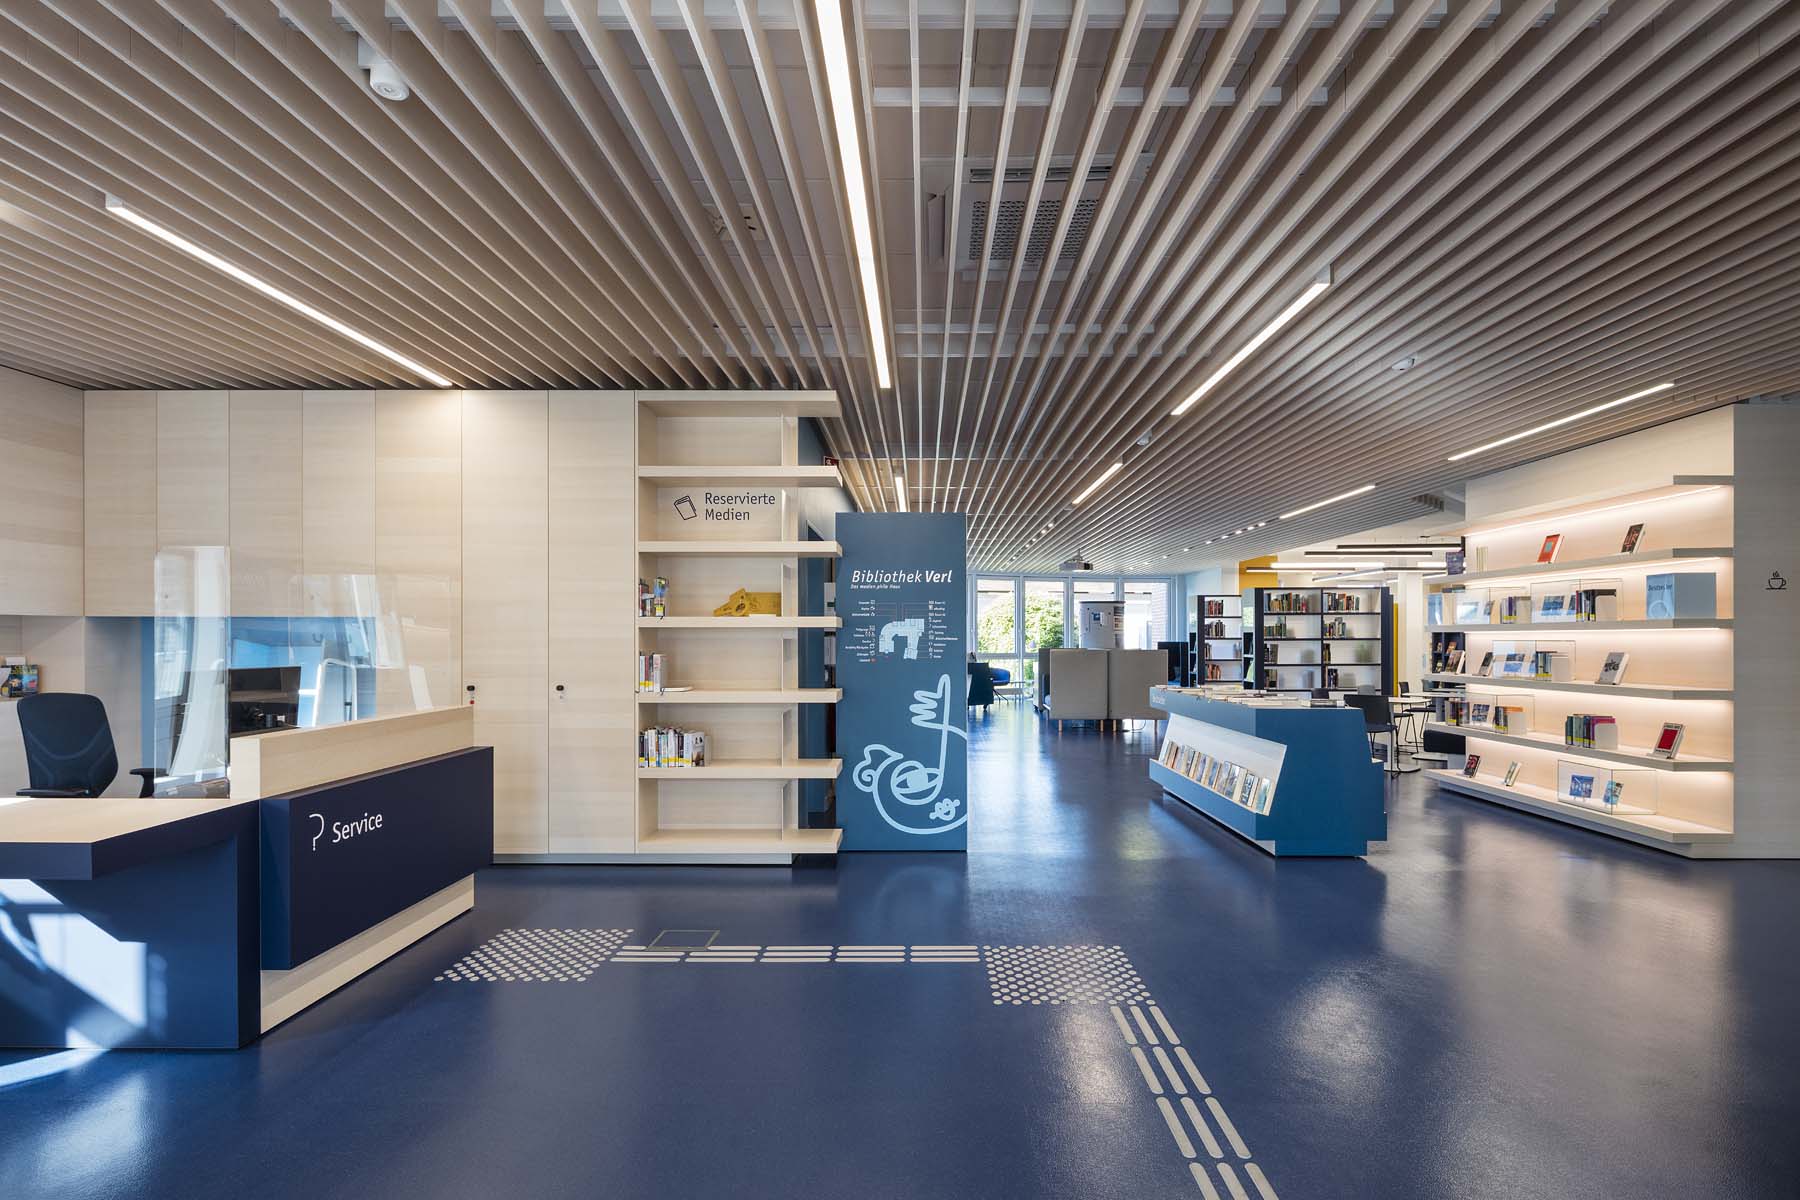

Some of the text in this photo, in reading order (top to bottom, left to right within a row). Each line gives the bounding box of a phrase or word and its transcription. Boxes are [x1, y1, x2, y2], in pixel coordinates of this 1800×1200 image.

[705, 492, 776, 505] Reservierte
[705, 508, 750, 520] Medien
[852, 569, 952, 583] Bibliothek Verl
[332, 812, 383, 843] Service
